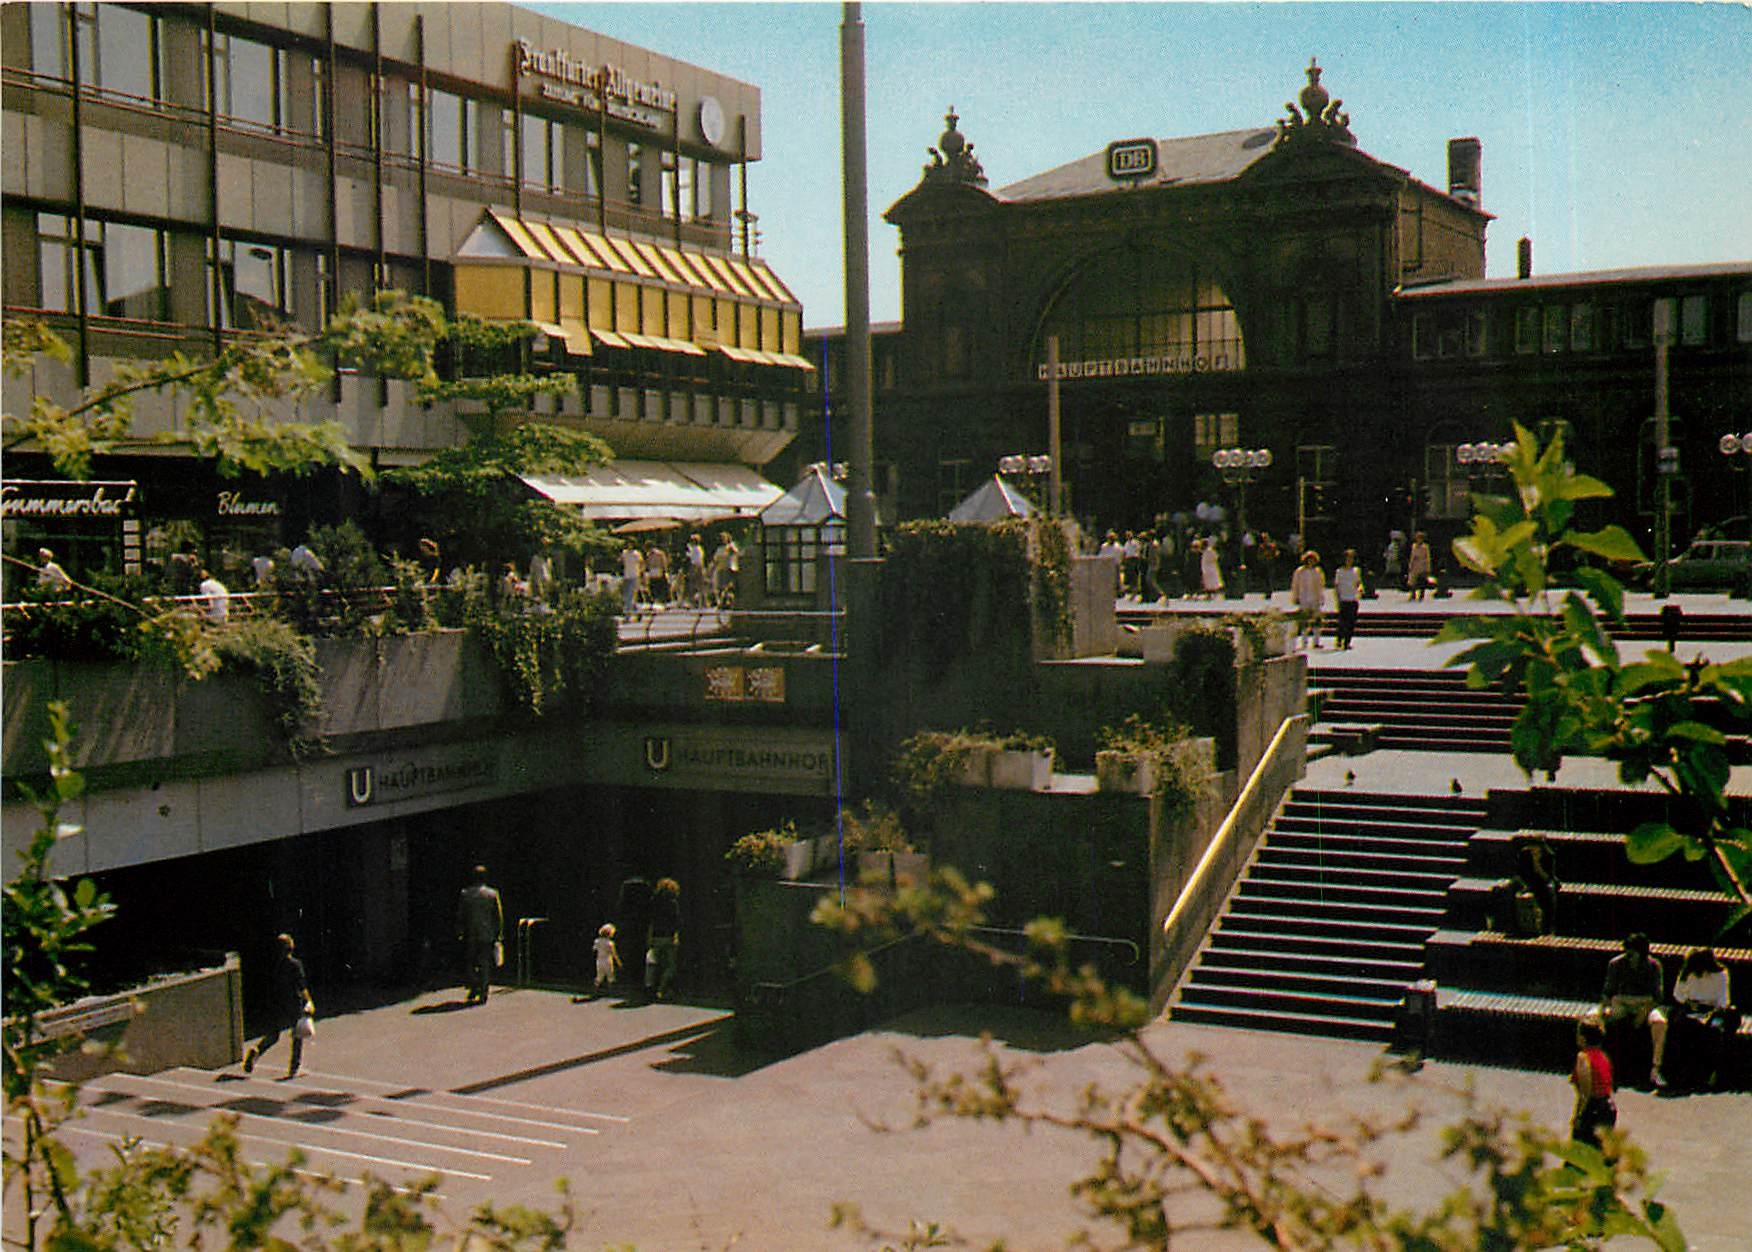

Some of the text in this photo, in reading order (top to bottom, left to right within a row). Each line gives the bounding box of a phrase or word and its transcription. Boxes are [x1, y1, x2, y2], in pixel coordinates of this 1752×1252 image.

[606, 63, 677, 112] Allgemeine
[1119, 151, 1146, 169] DB
[1038, 353, 1229, 379] HAUPTBAHNHOF
[217, 490, 279, 515] Blumen
[679, 748, 828, 770] HAUPTBAHNHOF
[379, 757, 496, 788] HAUPTBAH
